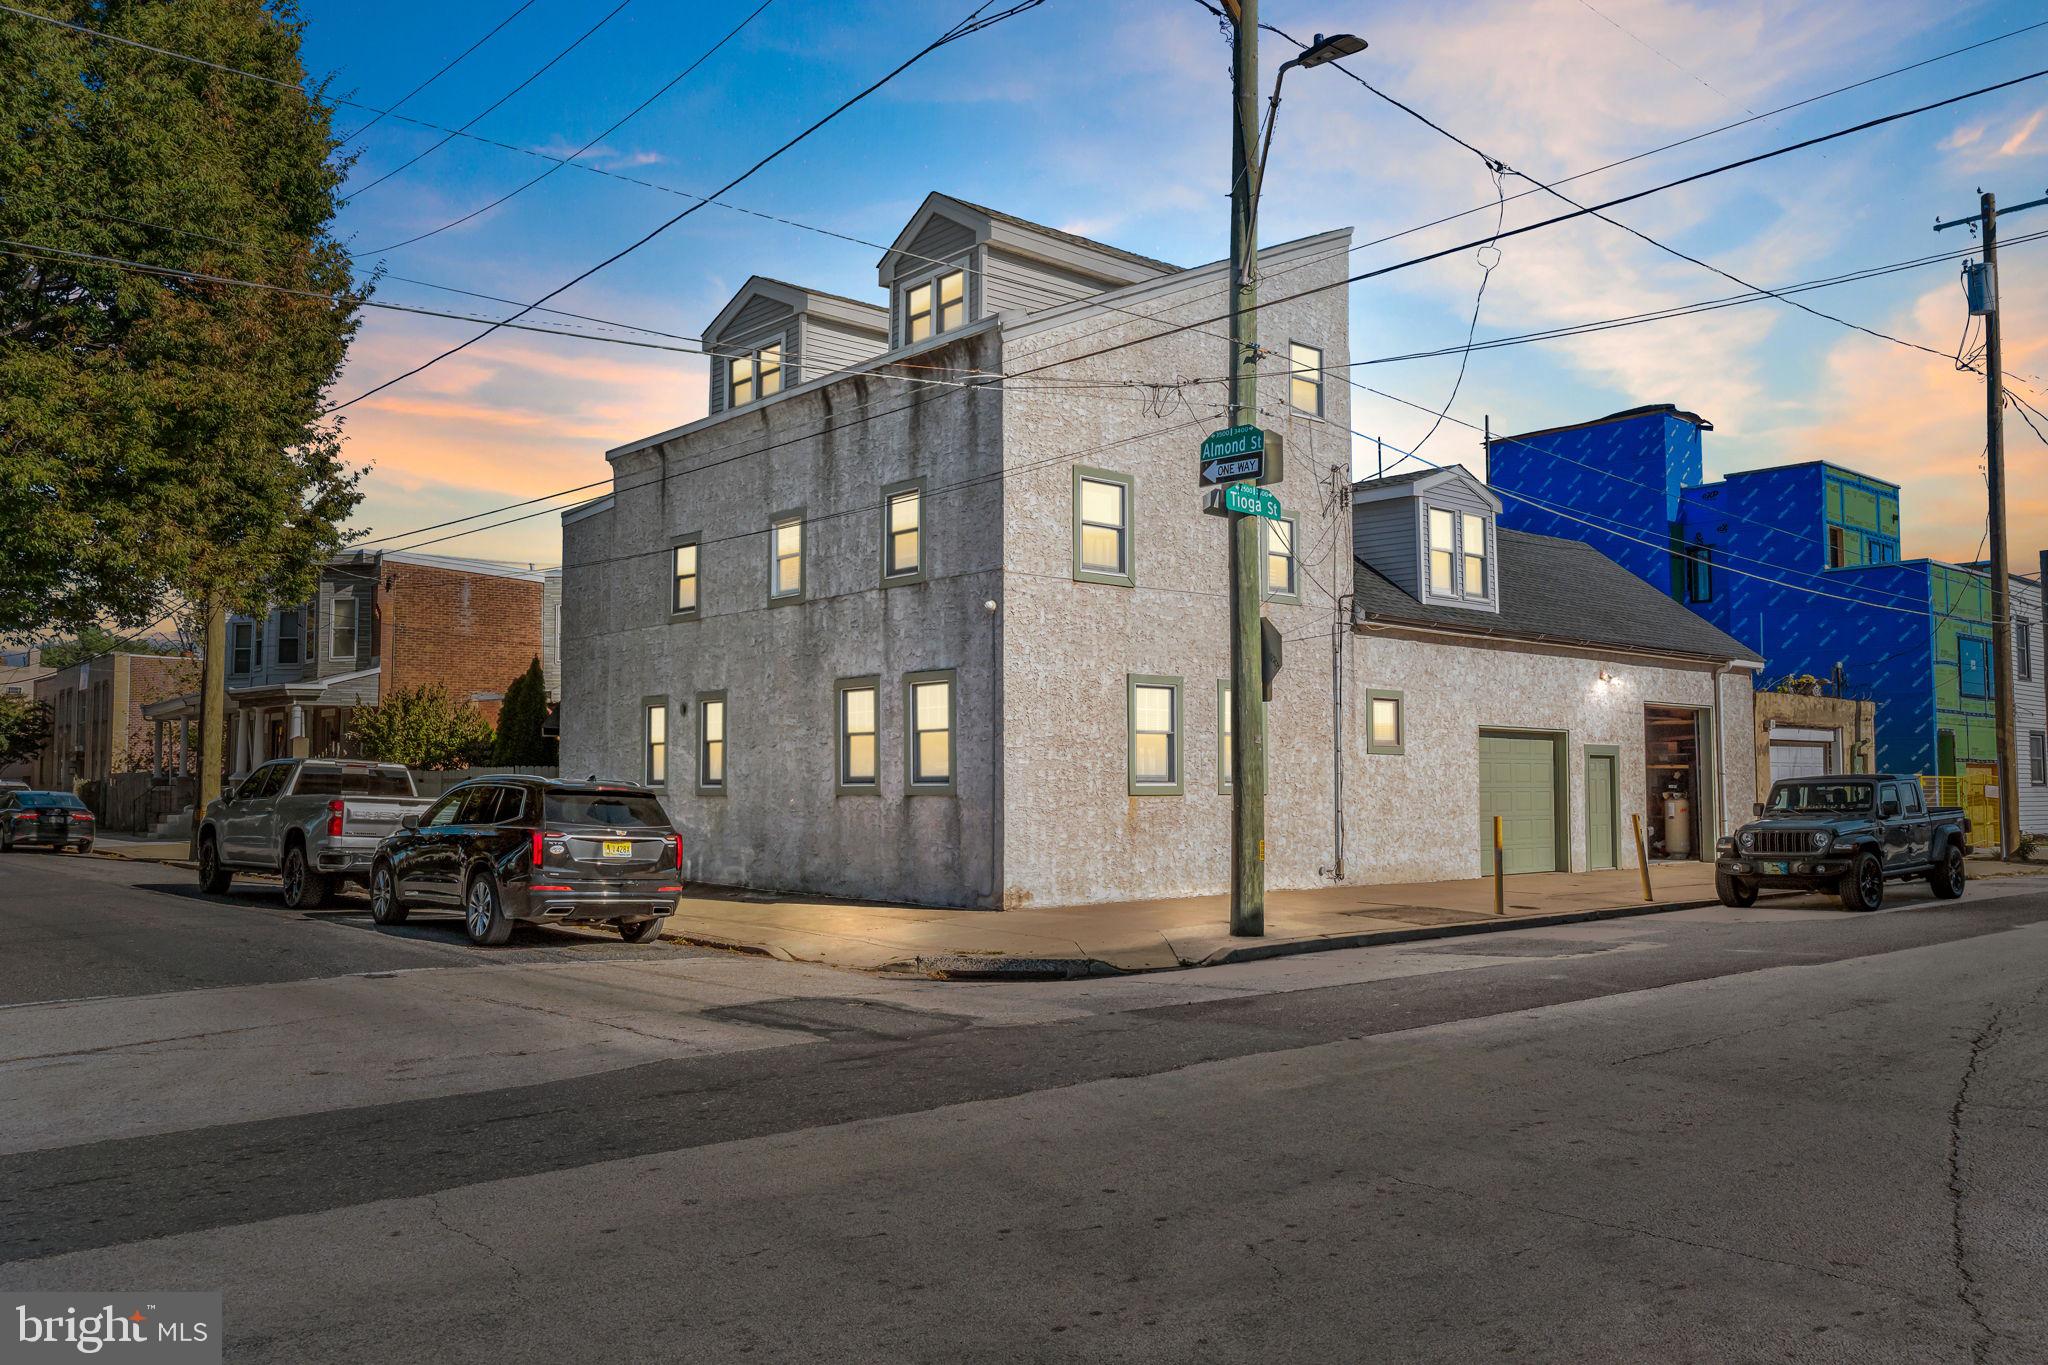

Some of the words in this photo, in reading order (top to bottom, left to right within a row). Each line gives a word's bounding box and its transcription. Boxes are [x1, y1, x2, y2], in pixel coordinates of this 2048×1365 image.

[1203, 437, 1246, 458] Almond
[1251, 436, 1262, 449] St
[1217, 464, 1234, 476] ONE
[1237, 460, 1256, 472] WAY
[1231, 492, 1261, 513] Tioga
[1267, 503, 1278, 517] St
